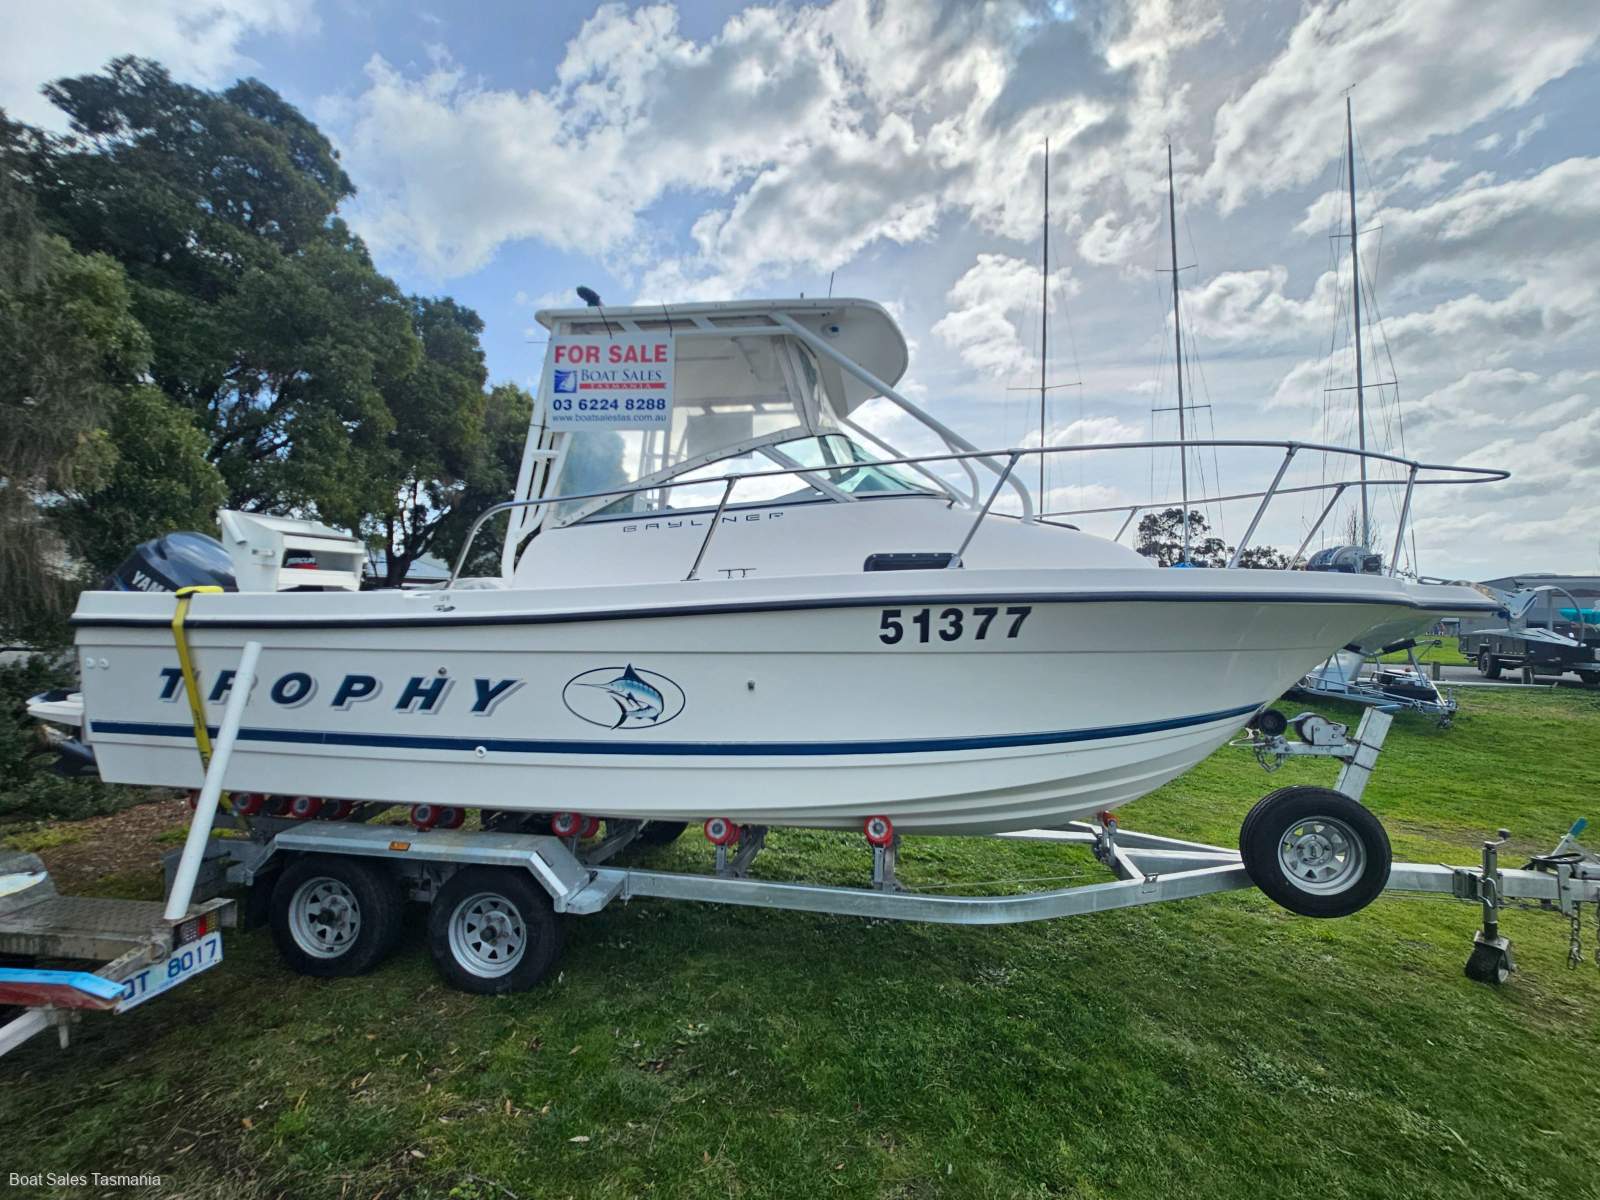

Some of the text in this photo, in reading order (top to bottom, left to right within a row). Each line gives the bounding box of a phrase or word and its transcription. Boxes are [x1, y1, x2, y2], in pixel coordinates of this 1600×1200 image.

[554, 344, 668, 364] FOR SALE
[553, 399, 666, 411] 03 6224 8288
[552, 414, 667, 422] www.boatsalestas.com.au
[879, 606, 1032, 645] 51377
[167, 938, 217, 978] 8017
